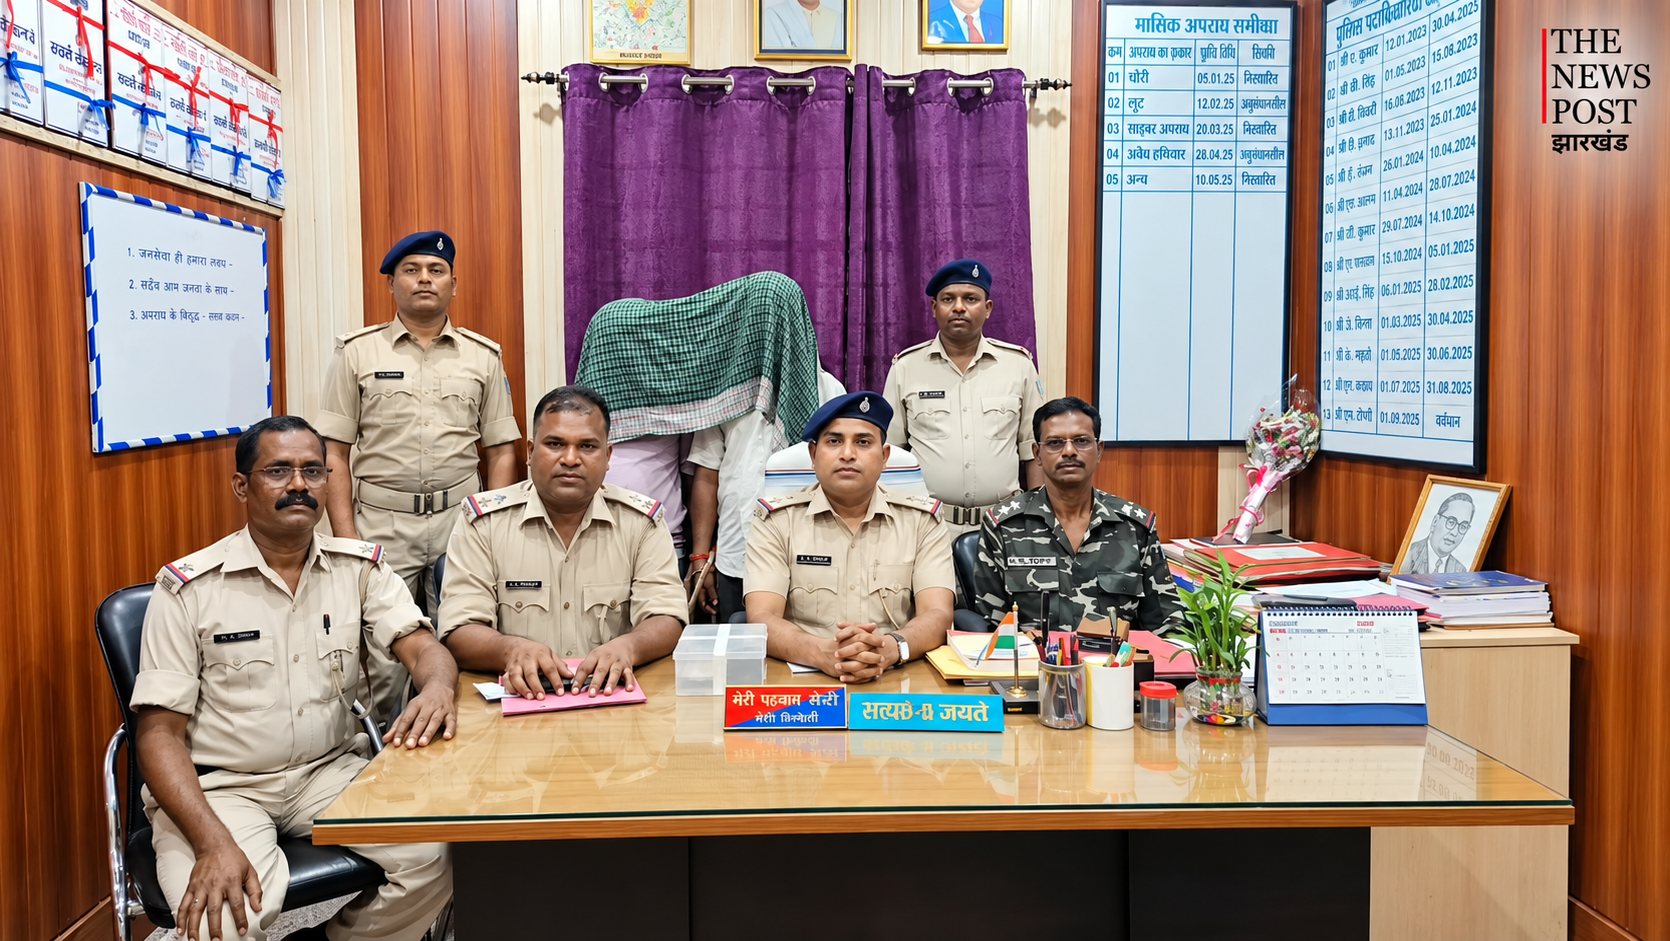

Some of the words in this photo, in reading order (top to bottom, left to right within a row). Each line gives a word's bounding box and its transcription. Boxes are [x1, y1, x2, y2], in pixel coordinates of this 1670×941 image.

[1134, 12, 1180, 33] मासिक
[1158, 46, 1168, 58] का
[1328, 59, 1335, 71] 01
[1359, 43, 1379, 64] कुमार
[1385, 24, 1427, 51] 12.01.2023
[1108, 72, 1120, 83] 01
[1198, 73, 1234, 84] 05.01.25
[1327, 88, 1335, 100] 02
[1384, 56, 1426, 81] 01.05.2023
[1108, 97, 1120, 108] 02
[1198, 98, 1234, 109] 12.02.25
[1326, 116, 1334, 129] 03
[1431, 67, 1478, 95] 12.11.2023
[1107, 123, 1119, 134] 03
[1196, 124, 1233, 134] 20.03.25
[1326, 146, 1334, 157] 04
[1384, 119, 1424, 141] 13.11.2023
[1430, 101, 1476, 127] 25.01.2024
[1107, 148, 1119, 159] 04
[1196, 149, 1233, 160] 28.04.25
[1325, 174, 1334, 186] 05
[1383, 150, 1424, 172] 26.01.2024
[1430, 135, 1476, 159] 10.04.2024
[1106, 174, 1118, 185] 05
[1196, 174, 1232, 185] 10.05.25
[1325, 203, 1334, 214] 06
[1383, 182, 1423, 202] 11.04.2024
[1429, 169, 1475, 192] 28.07.2024
[1324, 232, 1332, 243] 07
[1382, 214, 1422, 233] 29.07.2024
[1429, 204, 1475, 224] 14.10.2024
[128, 248, 135, 257] 1.
[138, 248, 170, 261] जनसेवा
[174, 251, 183, 264] ही
[186, 255, 207, 266] हमारा
[1324, 261, 1332, 272] 08
[1382, 247, 1422, 264] 15.10.2024
[1428, 239, 1474, 258] 05.01.2025
[129, 280, 137, 290] 2.
[164, 282, 178, 292] आम
[206, 282, 212, 293] के
[1324, 291, 1332, 302] 09
[1381, 281, 1422, 297] 06.01.2025
[1428, 274, 1474, 292] 28.02.2025
[130, 310, 138, 320] 3.
[170, 308, 177, 320] के
[1324, 321, 1332, 332] 10
[1381, 314, 1421, 329] 01.03.2025
[1428, 310, 1473, 326] 30.04.2025
[1324, 350, 1330, 361] 11
[1380, 348, 1420, 361] 01.05.2025
[1427, 346, 1472, 360] 30.06.2025
[1323, 380, 1331, 391] 12
[1380, 380, 1420, 393] 01.07.2025
[1427, 381, 1472, 394] 31.08.2025
[1323, 409, 1330, 420] 13
[1380, 413, 1420, 426] 01.09.2025
[732, 690, 755, 706] मेरी
[938, 701, 989, 721] जयते
